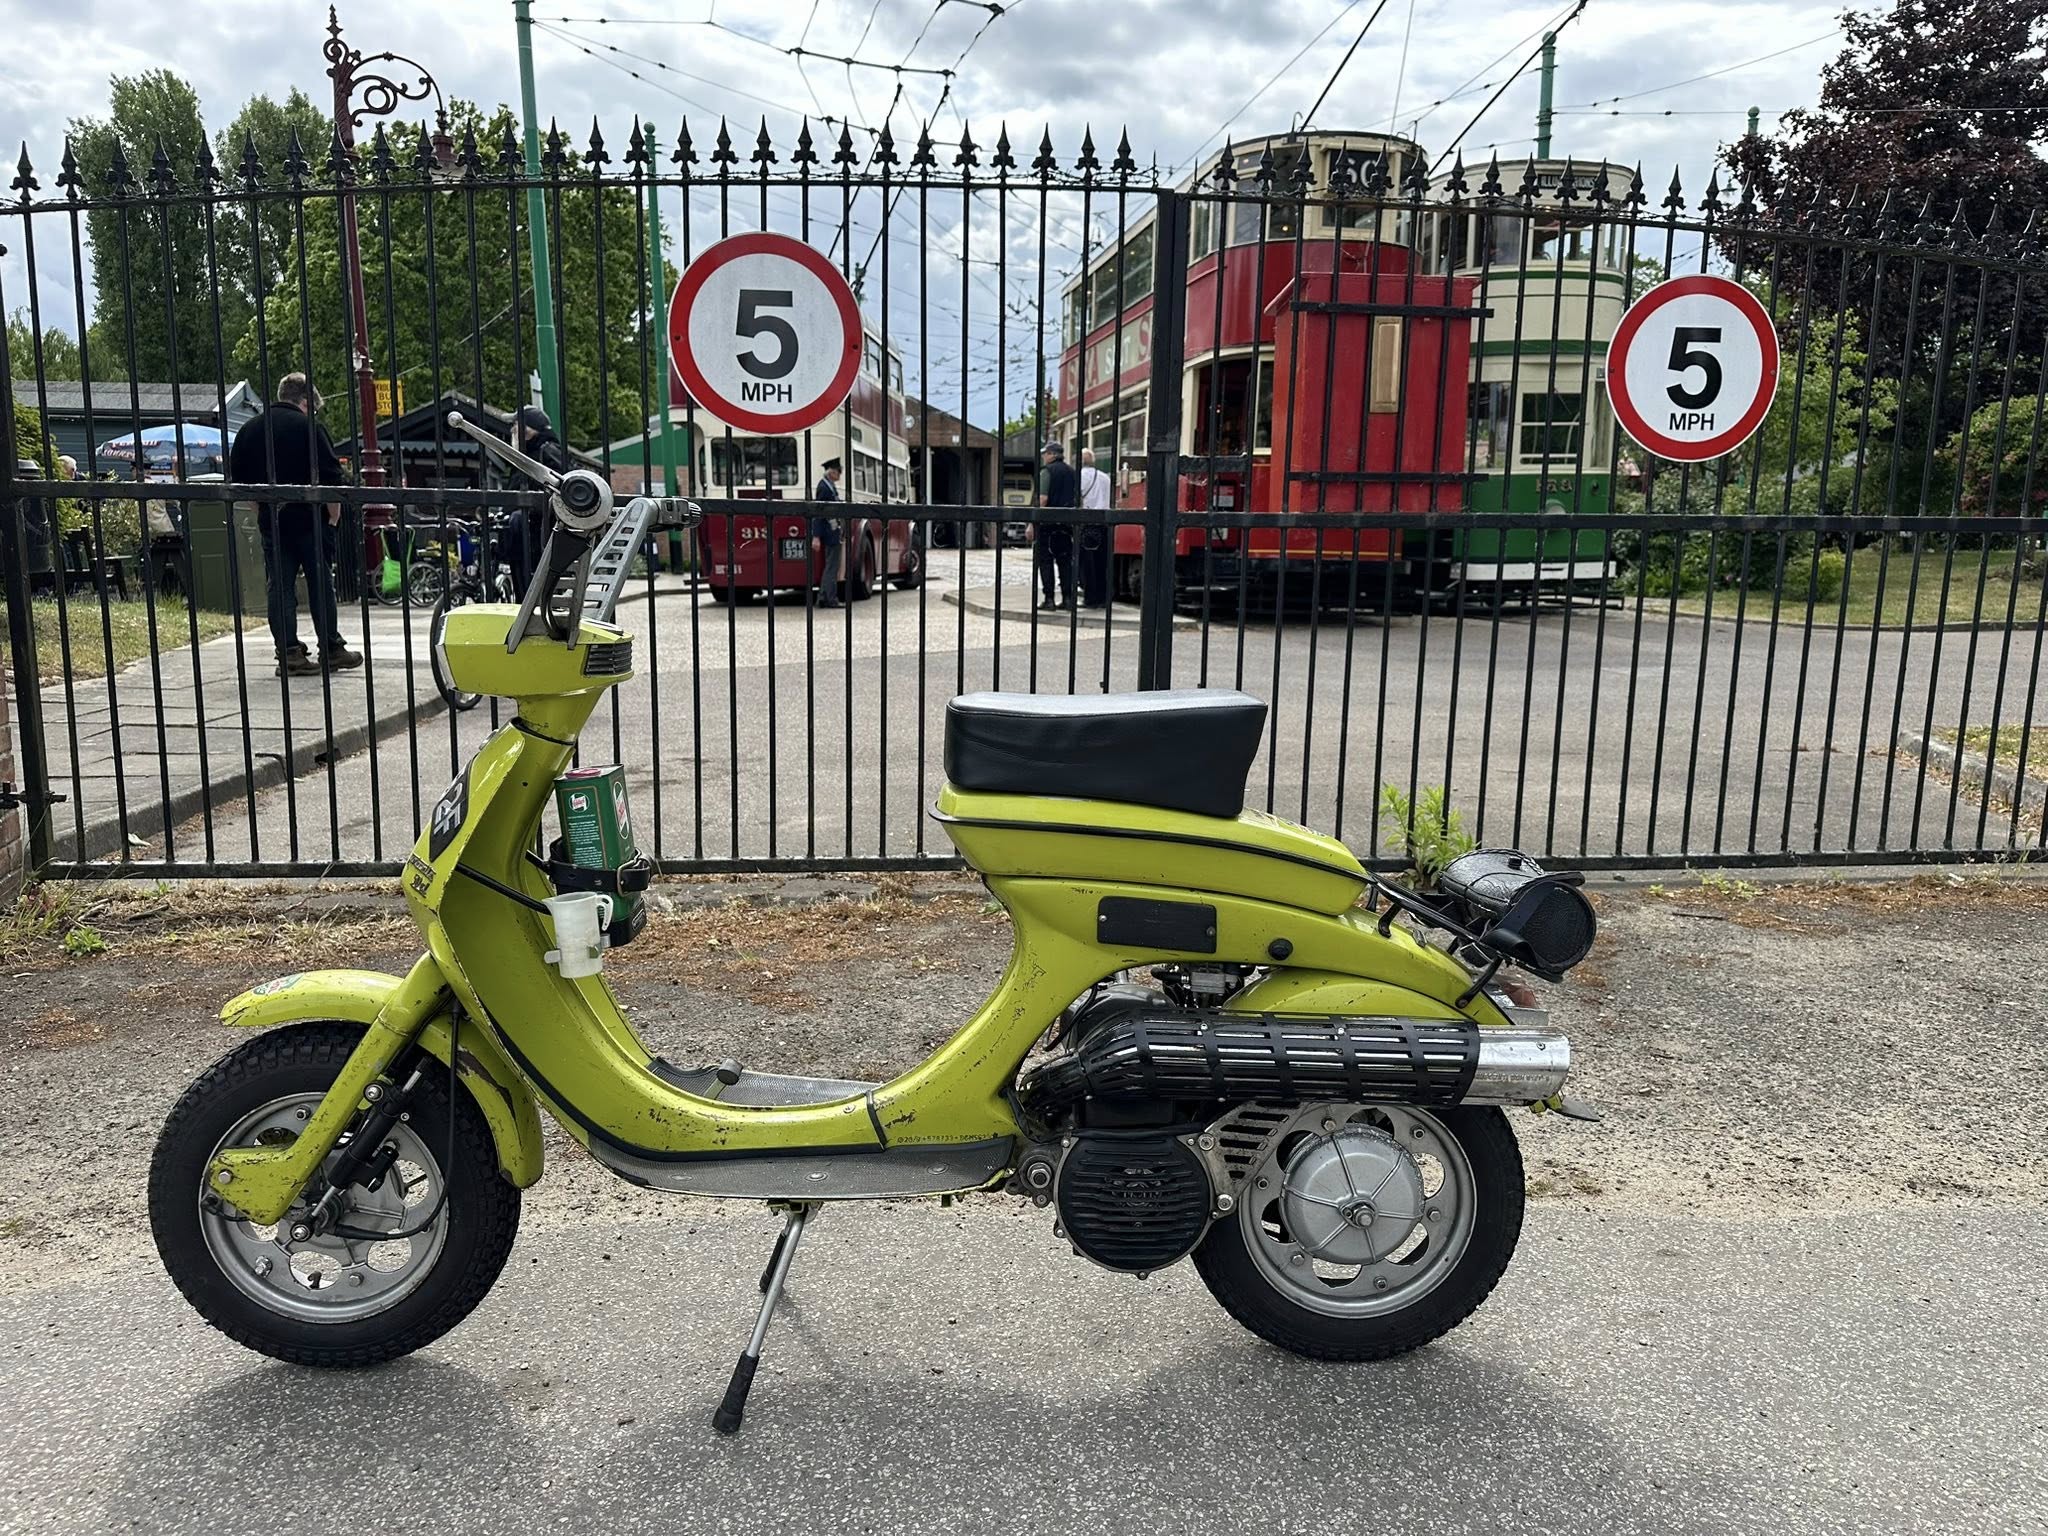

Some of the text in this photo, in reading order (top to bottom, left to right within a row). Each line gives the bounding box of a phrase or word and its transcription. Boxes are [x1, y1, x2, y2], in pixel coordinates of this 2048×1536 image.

[736, 289, 799, 380] 5
[741, 382, 793, 403] MPH
[1666, 327, 1722, 410] 5
[1669, 413, 1715, 431] MPH
